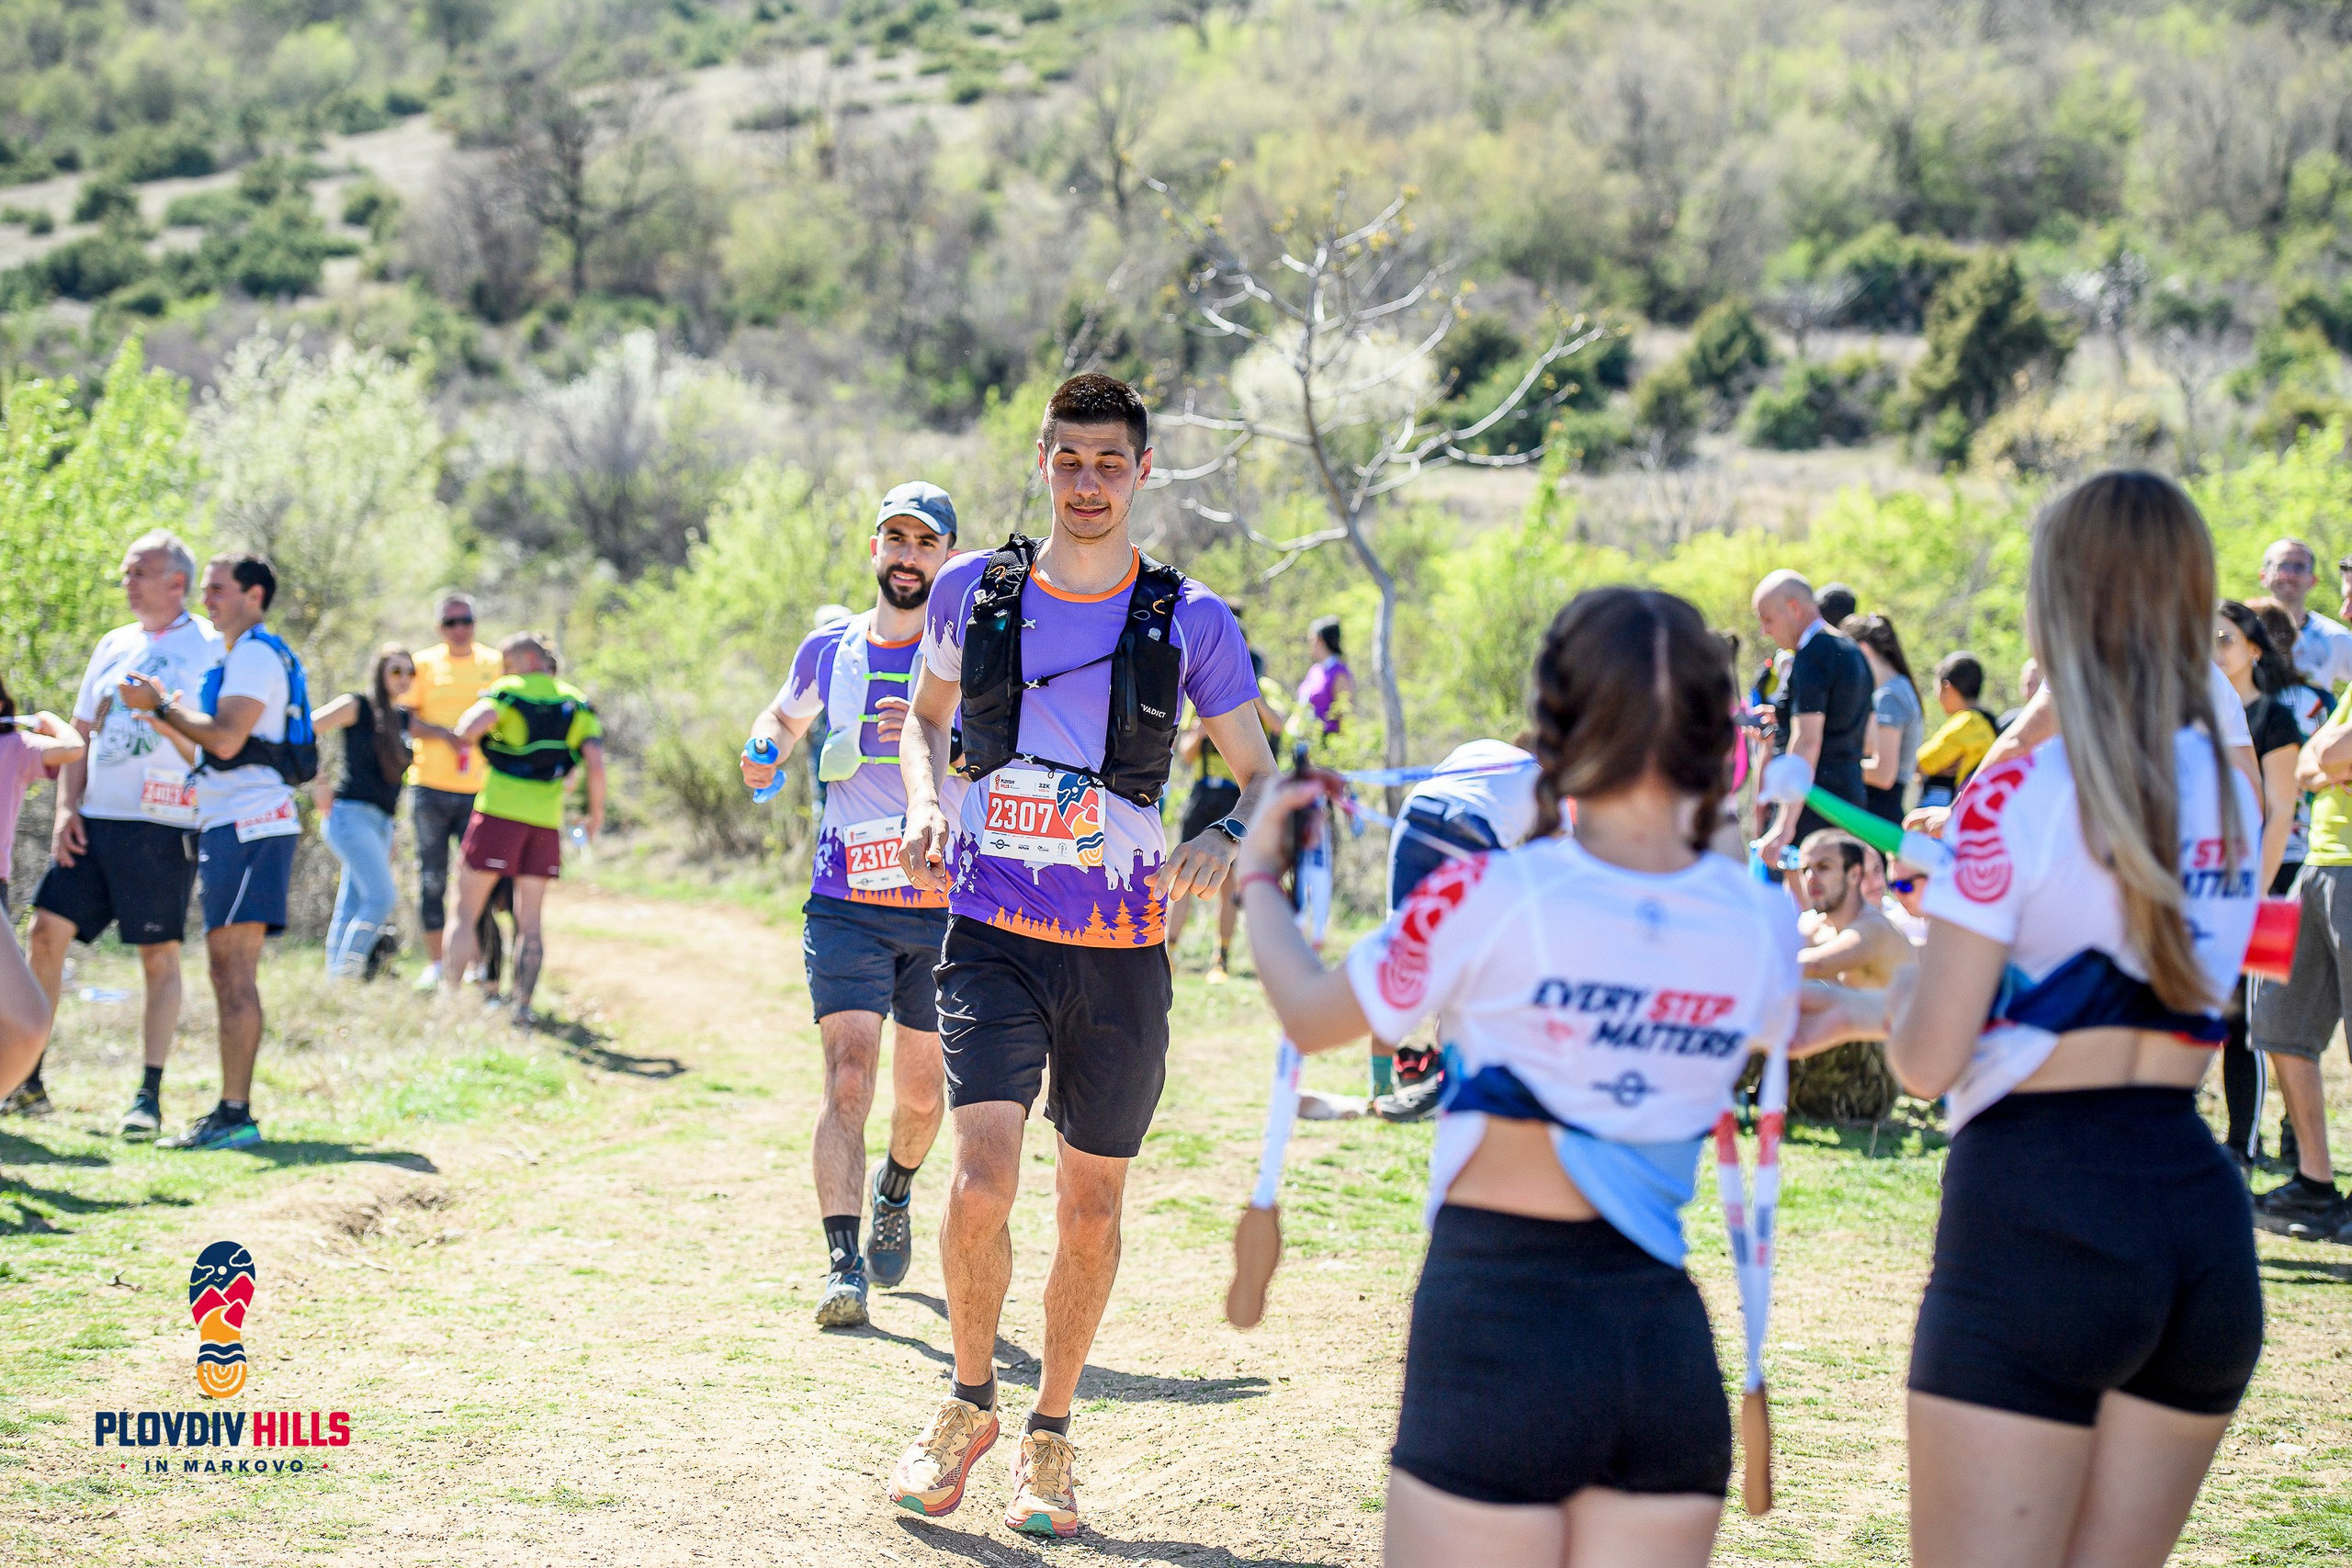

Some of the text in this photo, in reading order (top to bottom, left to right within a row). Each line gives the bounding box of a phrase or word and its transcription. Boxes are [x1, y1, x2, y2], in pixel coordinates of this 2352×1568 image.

[988, 797, 1055, 835] 2307
[850, 840, 899, 873] 2312
[1533, 978, 1736, 1026] EVERY STEP
[1590, 1020, 1745, 1057] MATTERS
